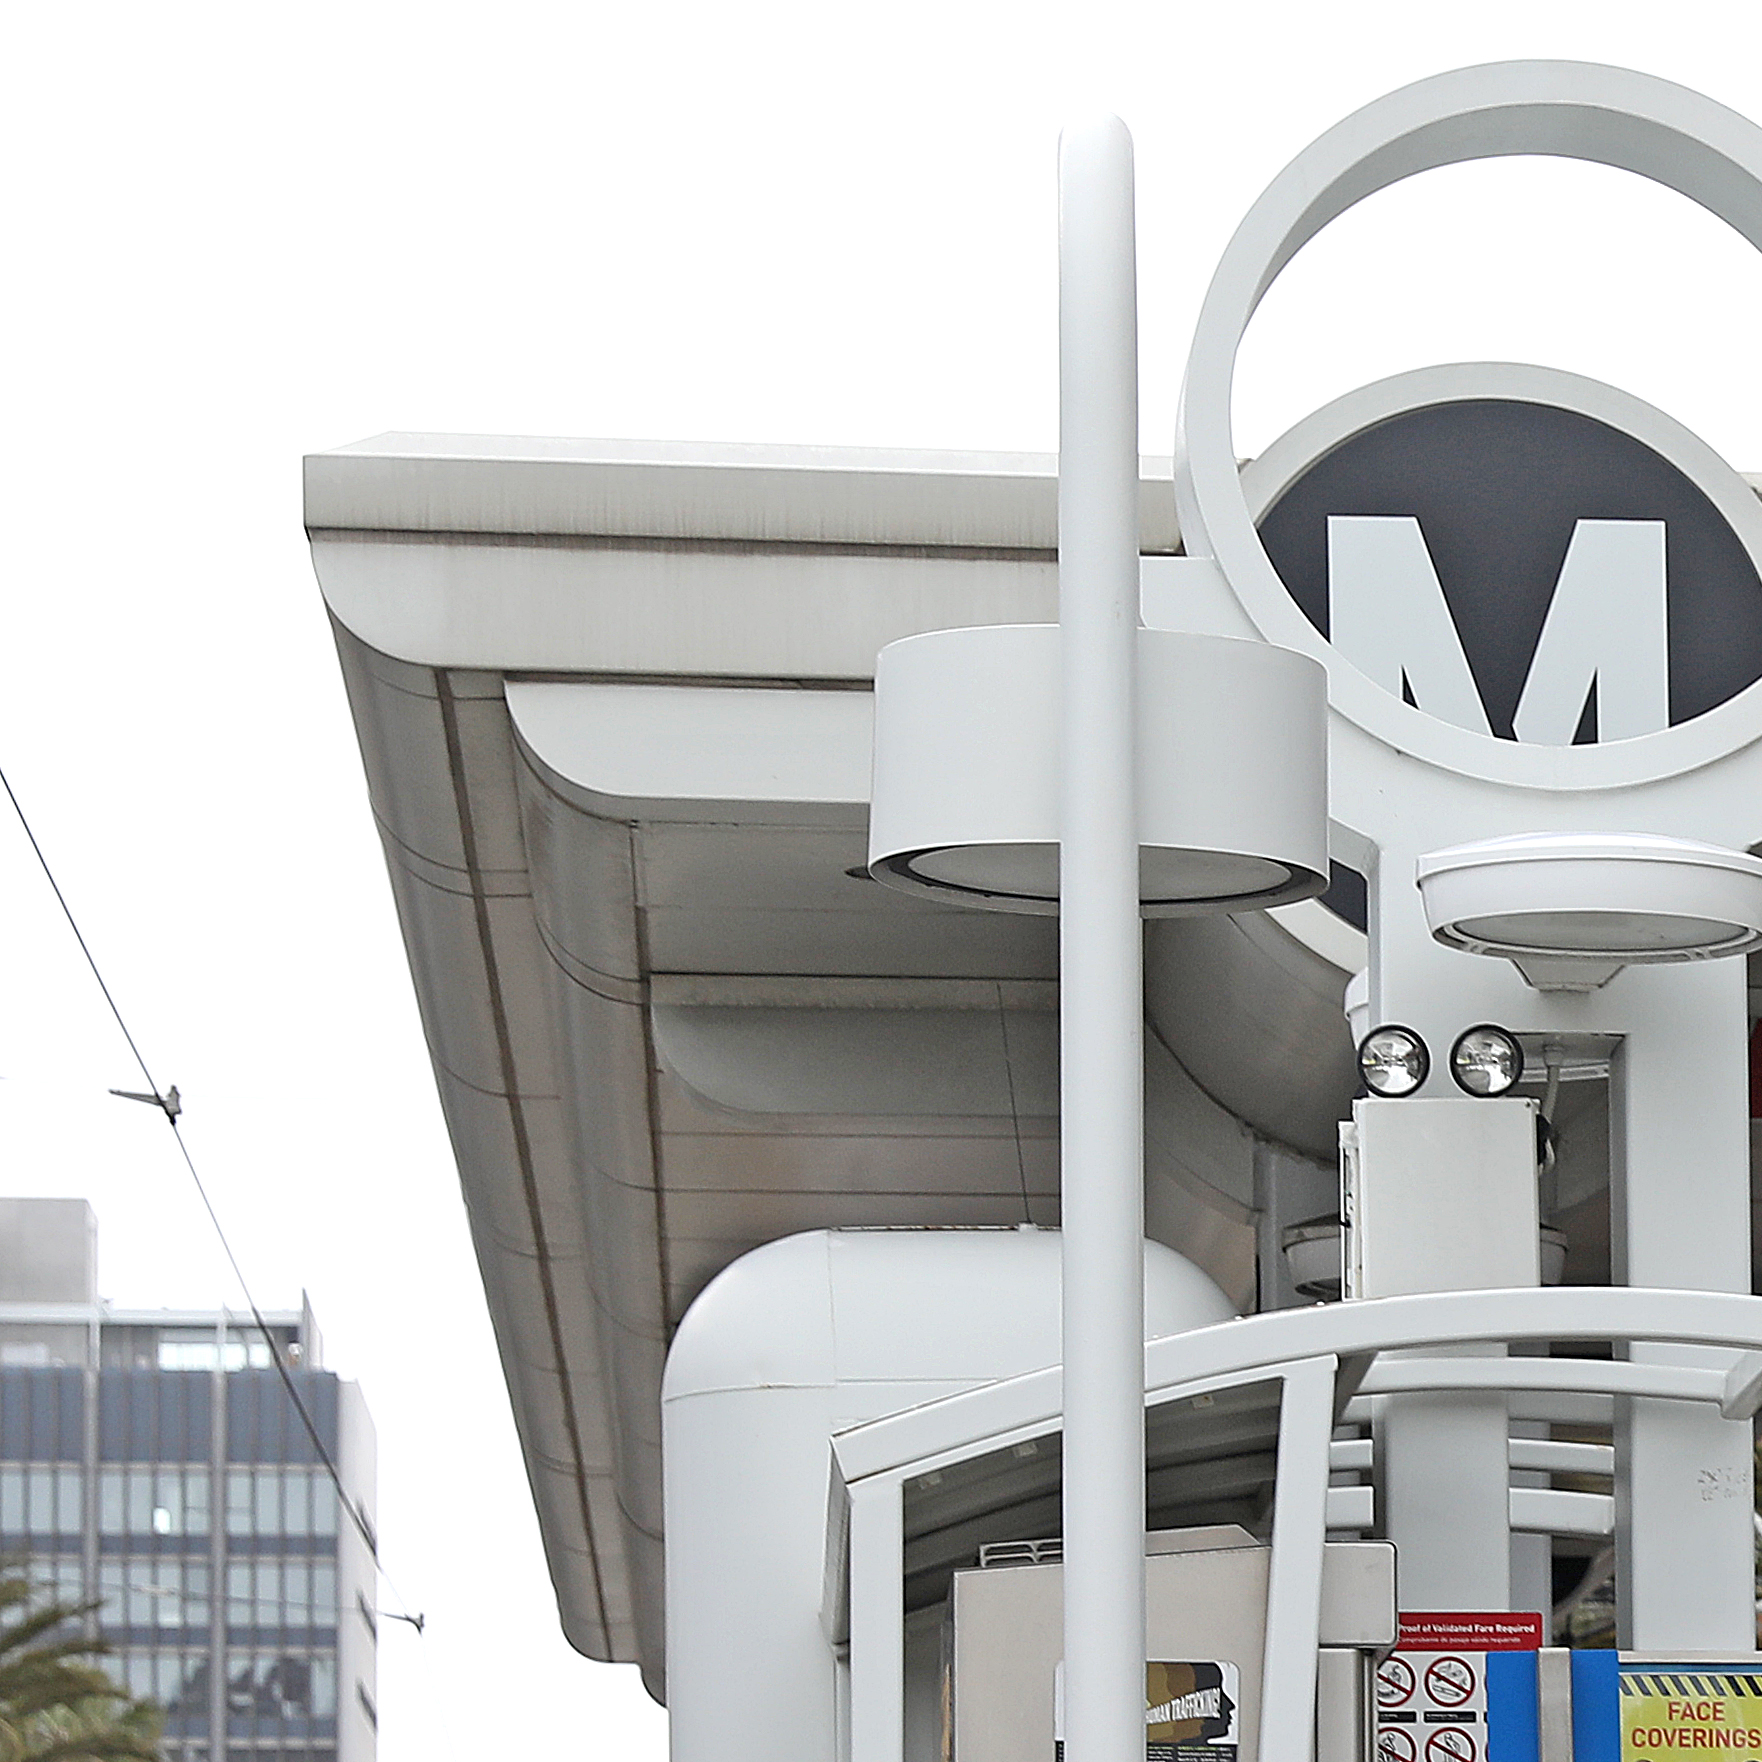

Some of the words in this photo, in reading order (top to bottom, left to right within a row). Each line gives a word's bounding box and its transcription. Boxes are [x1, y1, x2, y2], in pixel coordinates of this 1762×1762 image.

[1328, 515, 1670, 747] M
[1422, 1624, 1432, 1633] of
[1432, 1624, 1473, 1634] Validated
[1474, 1624, 1494, 1633] Fare
[1496, 1624, 1535, 1635] Required
[1146, 1703, 1171, 1724] UMAN
[1668, 1701, 1726, 1721] FACE
[1631, 1727, 1762, 1749] COVERINGS
